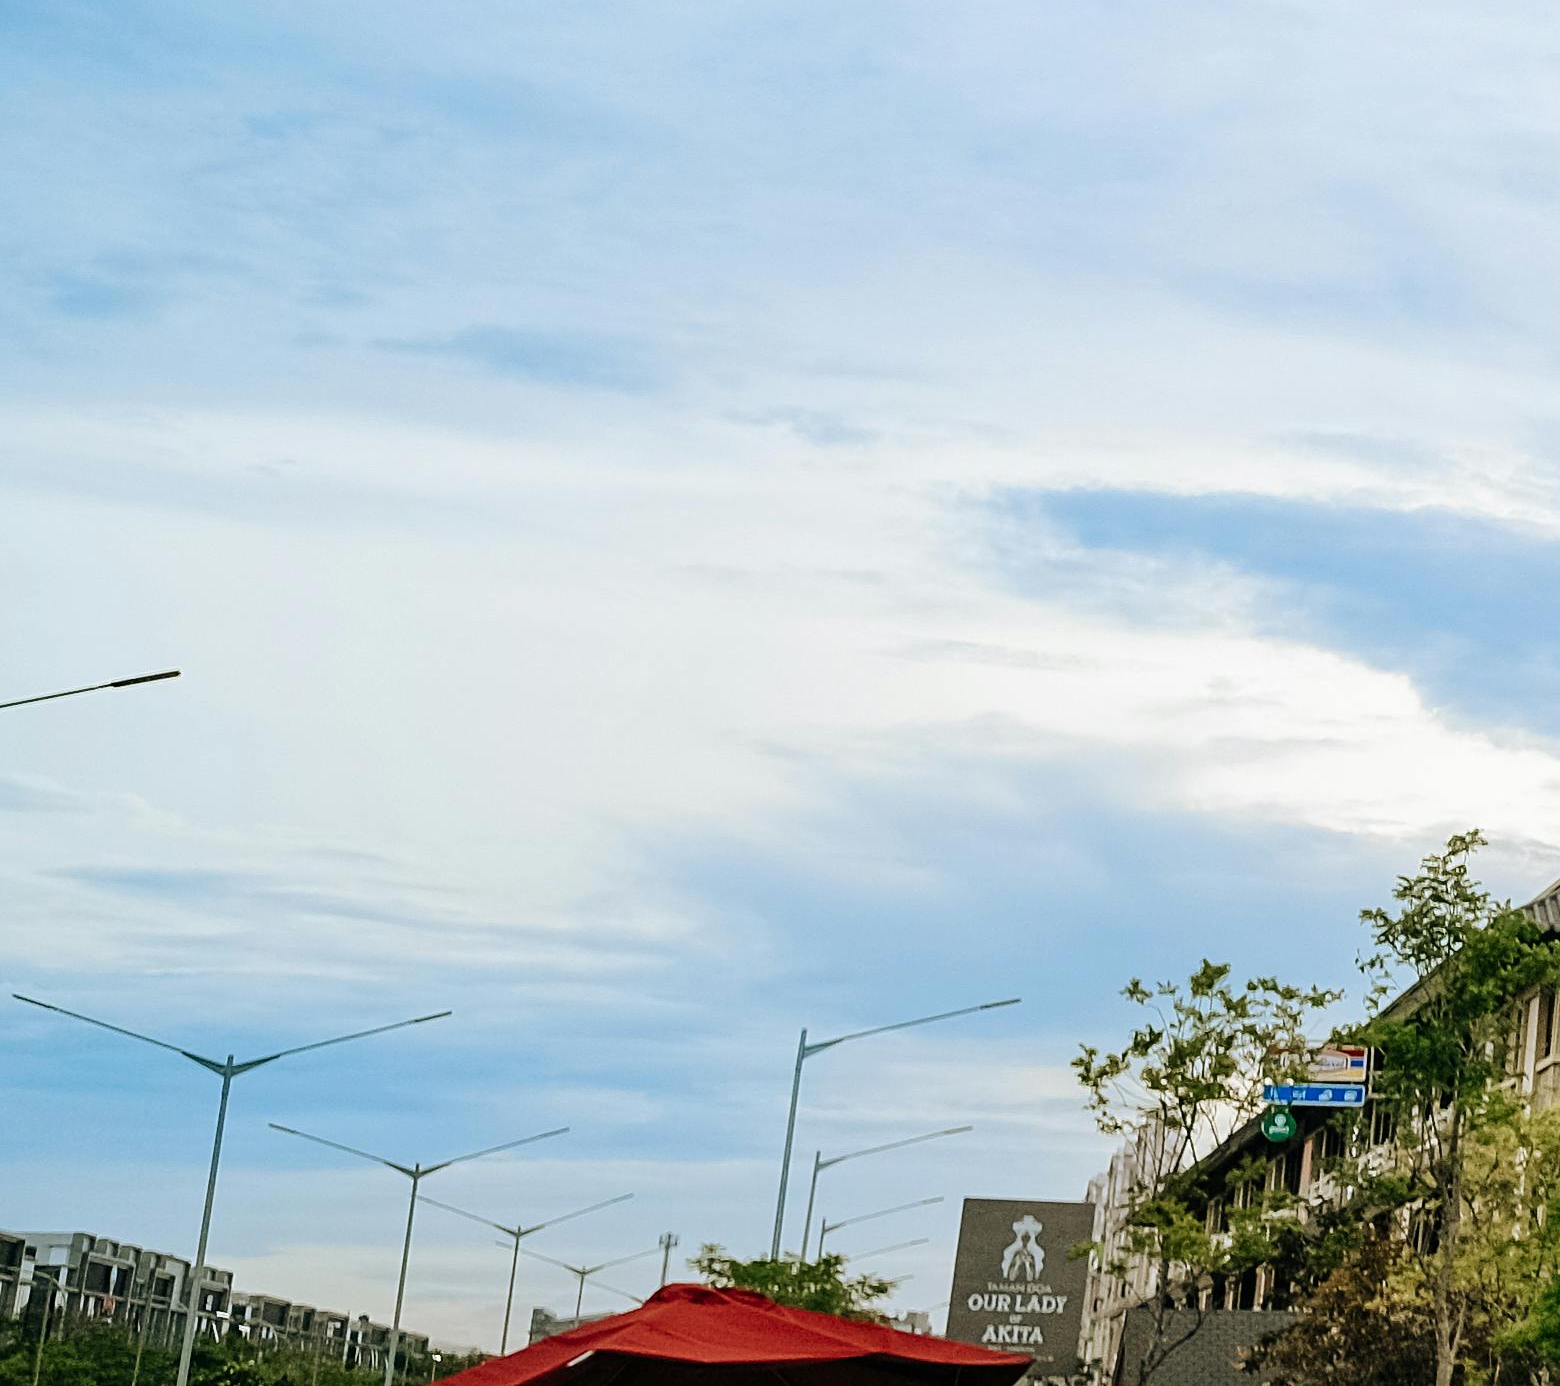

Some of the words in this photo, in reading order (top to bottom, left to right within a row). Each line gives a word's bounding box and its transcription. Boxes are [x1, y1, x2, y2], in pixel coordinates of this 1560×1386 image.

[967, 1293, 1011, 1312] OUR
[1014, 1294, 1068, 1314] LADY
[981, 1324, 1044, 1344] AKITA
